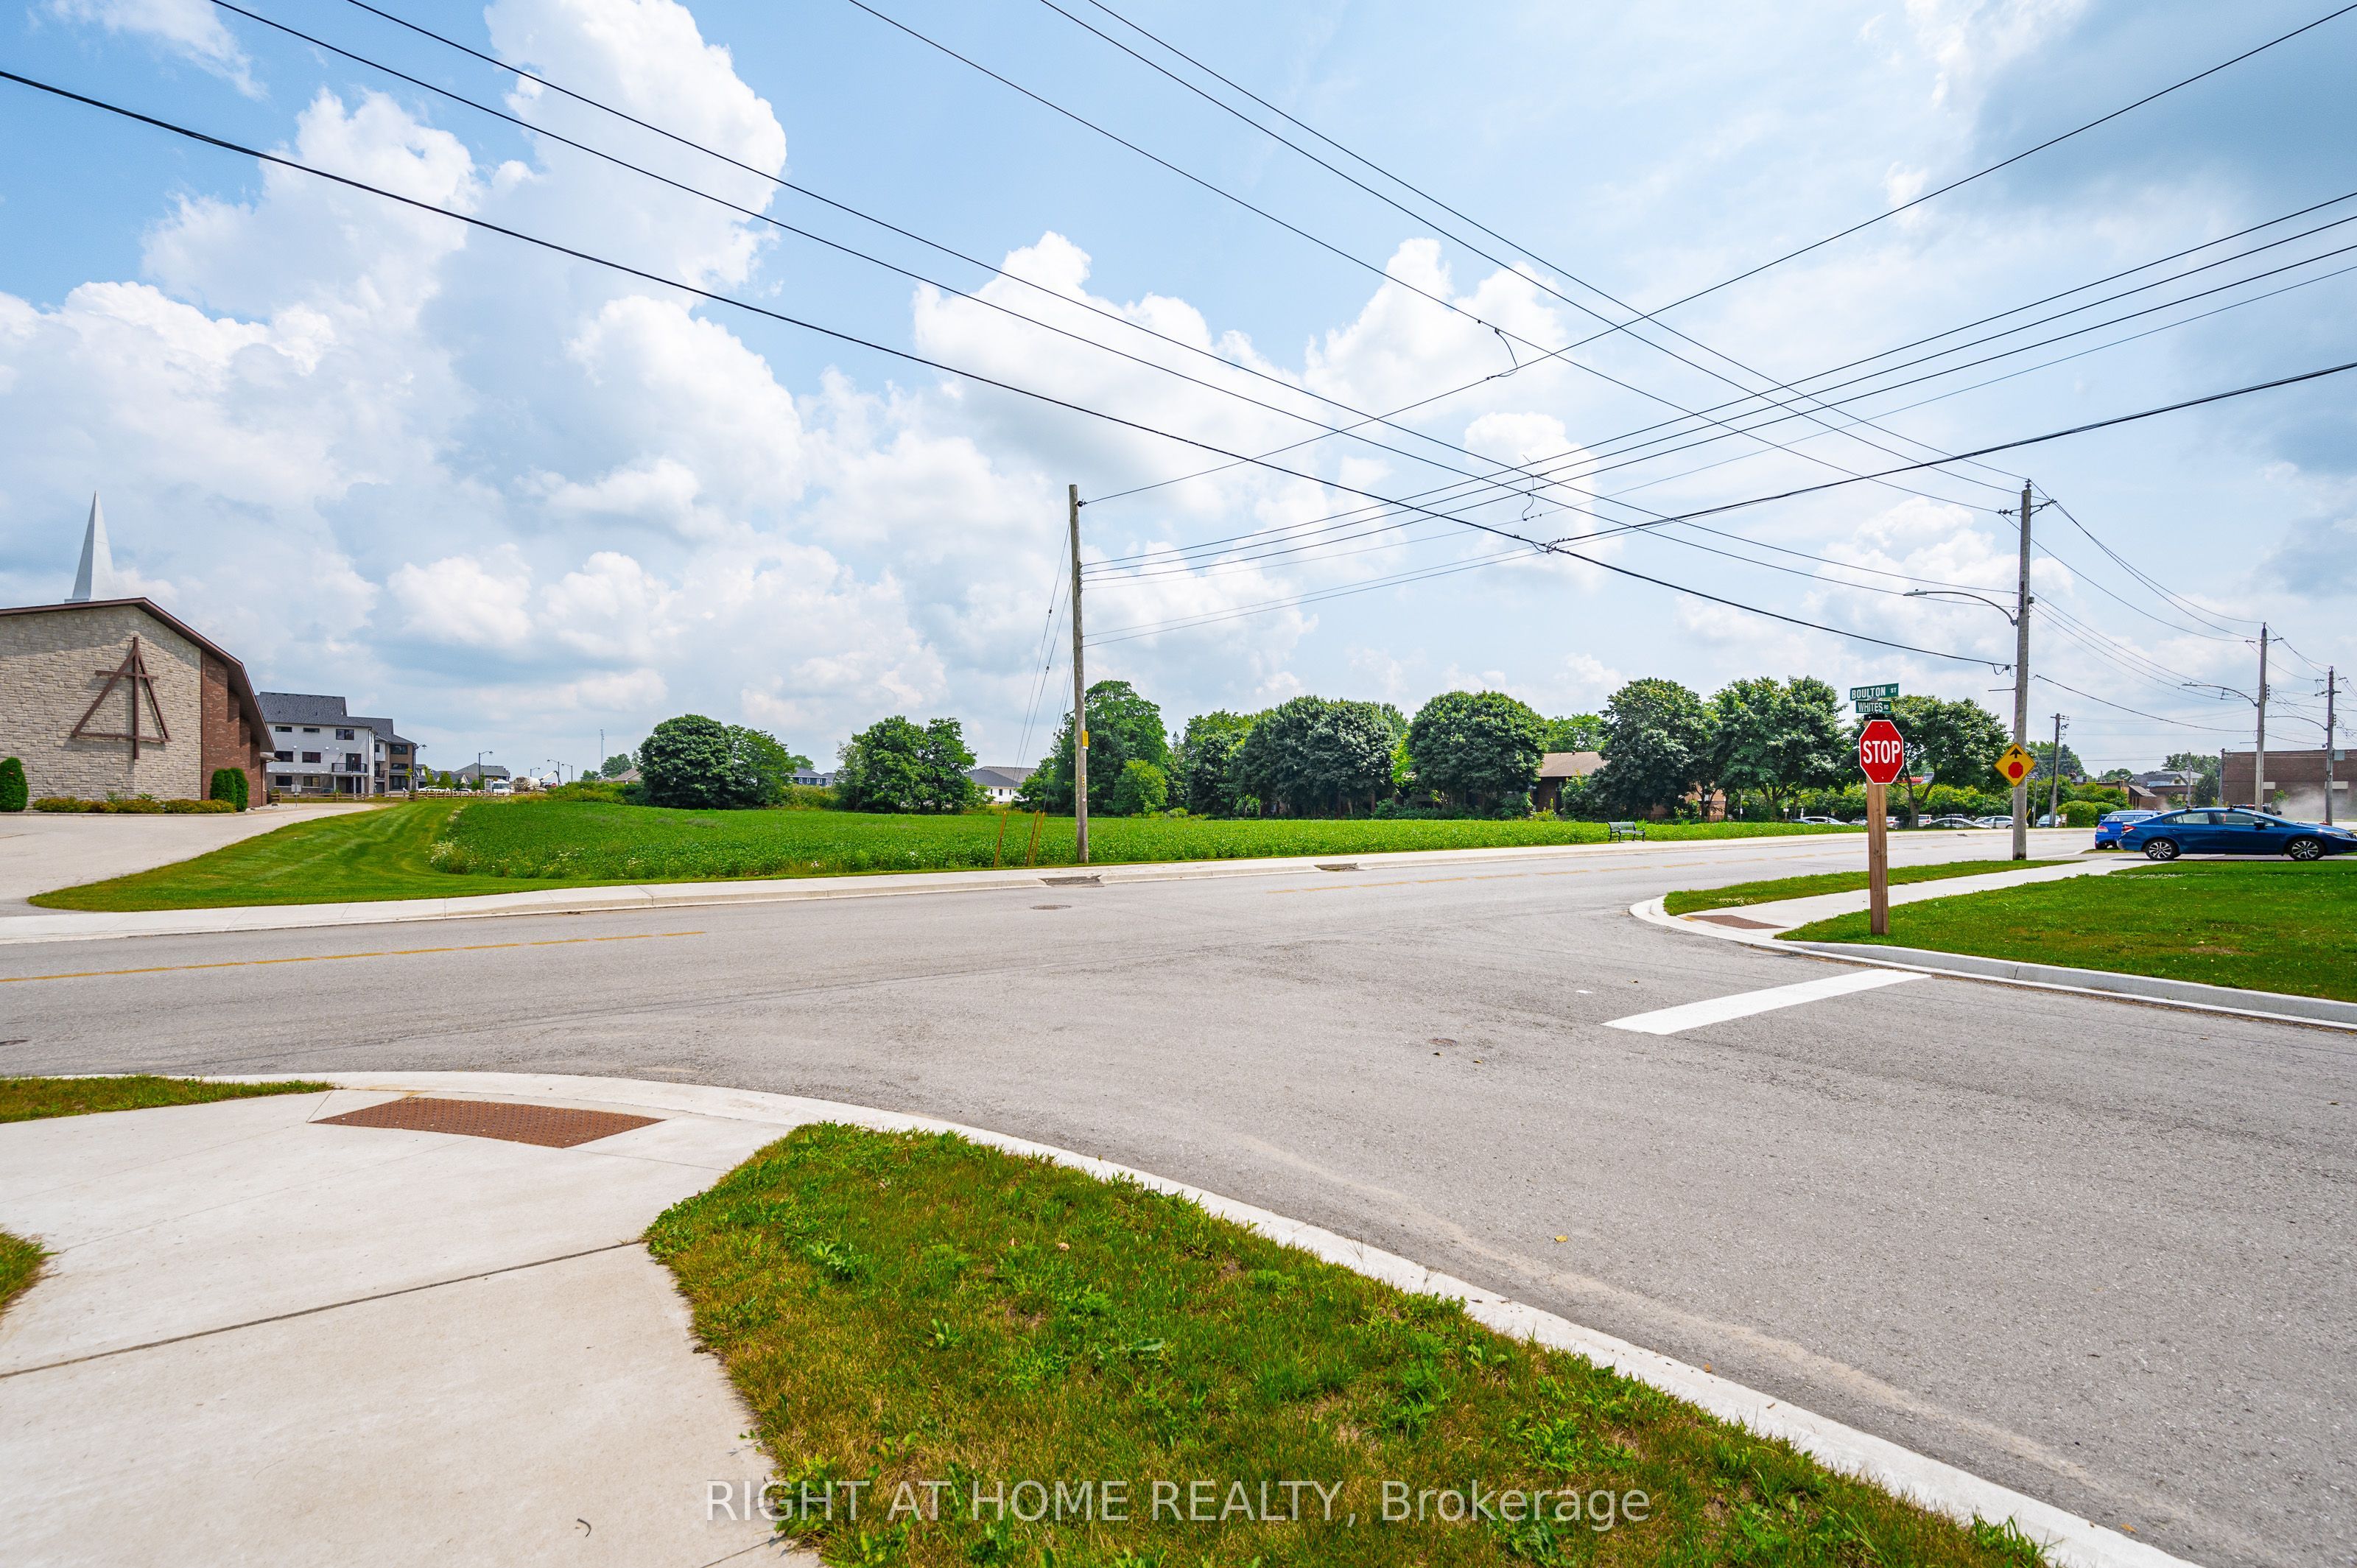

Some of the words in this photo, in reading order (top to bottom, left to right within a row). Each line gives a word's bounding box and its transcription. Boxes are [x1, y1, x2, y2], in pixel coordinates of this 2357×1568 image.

[1851, 686, 1886, 700] BOULTON
[1858, 702, 1883, 712] WHITES
[1863, 739, 1901, 764] STOP
